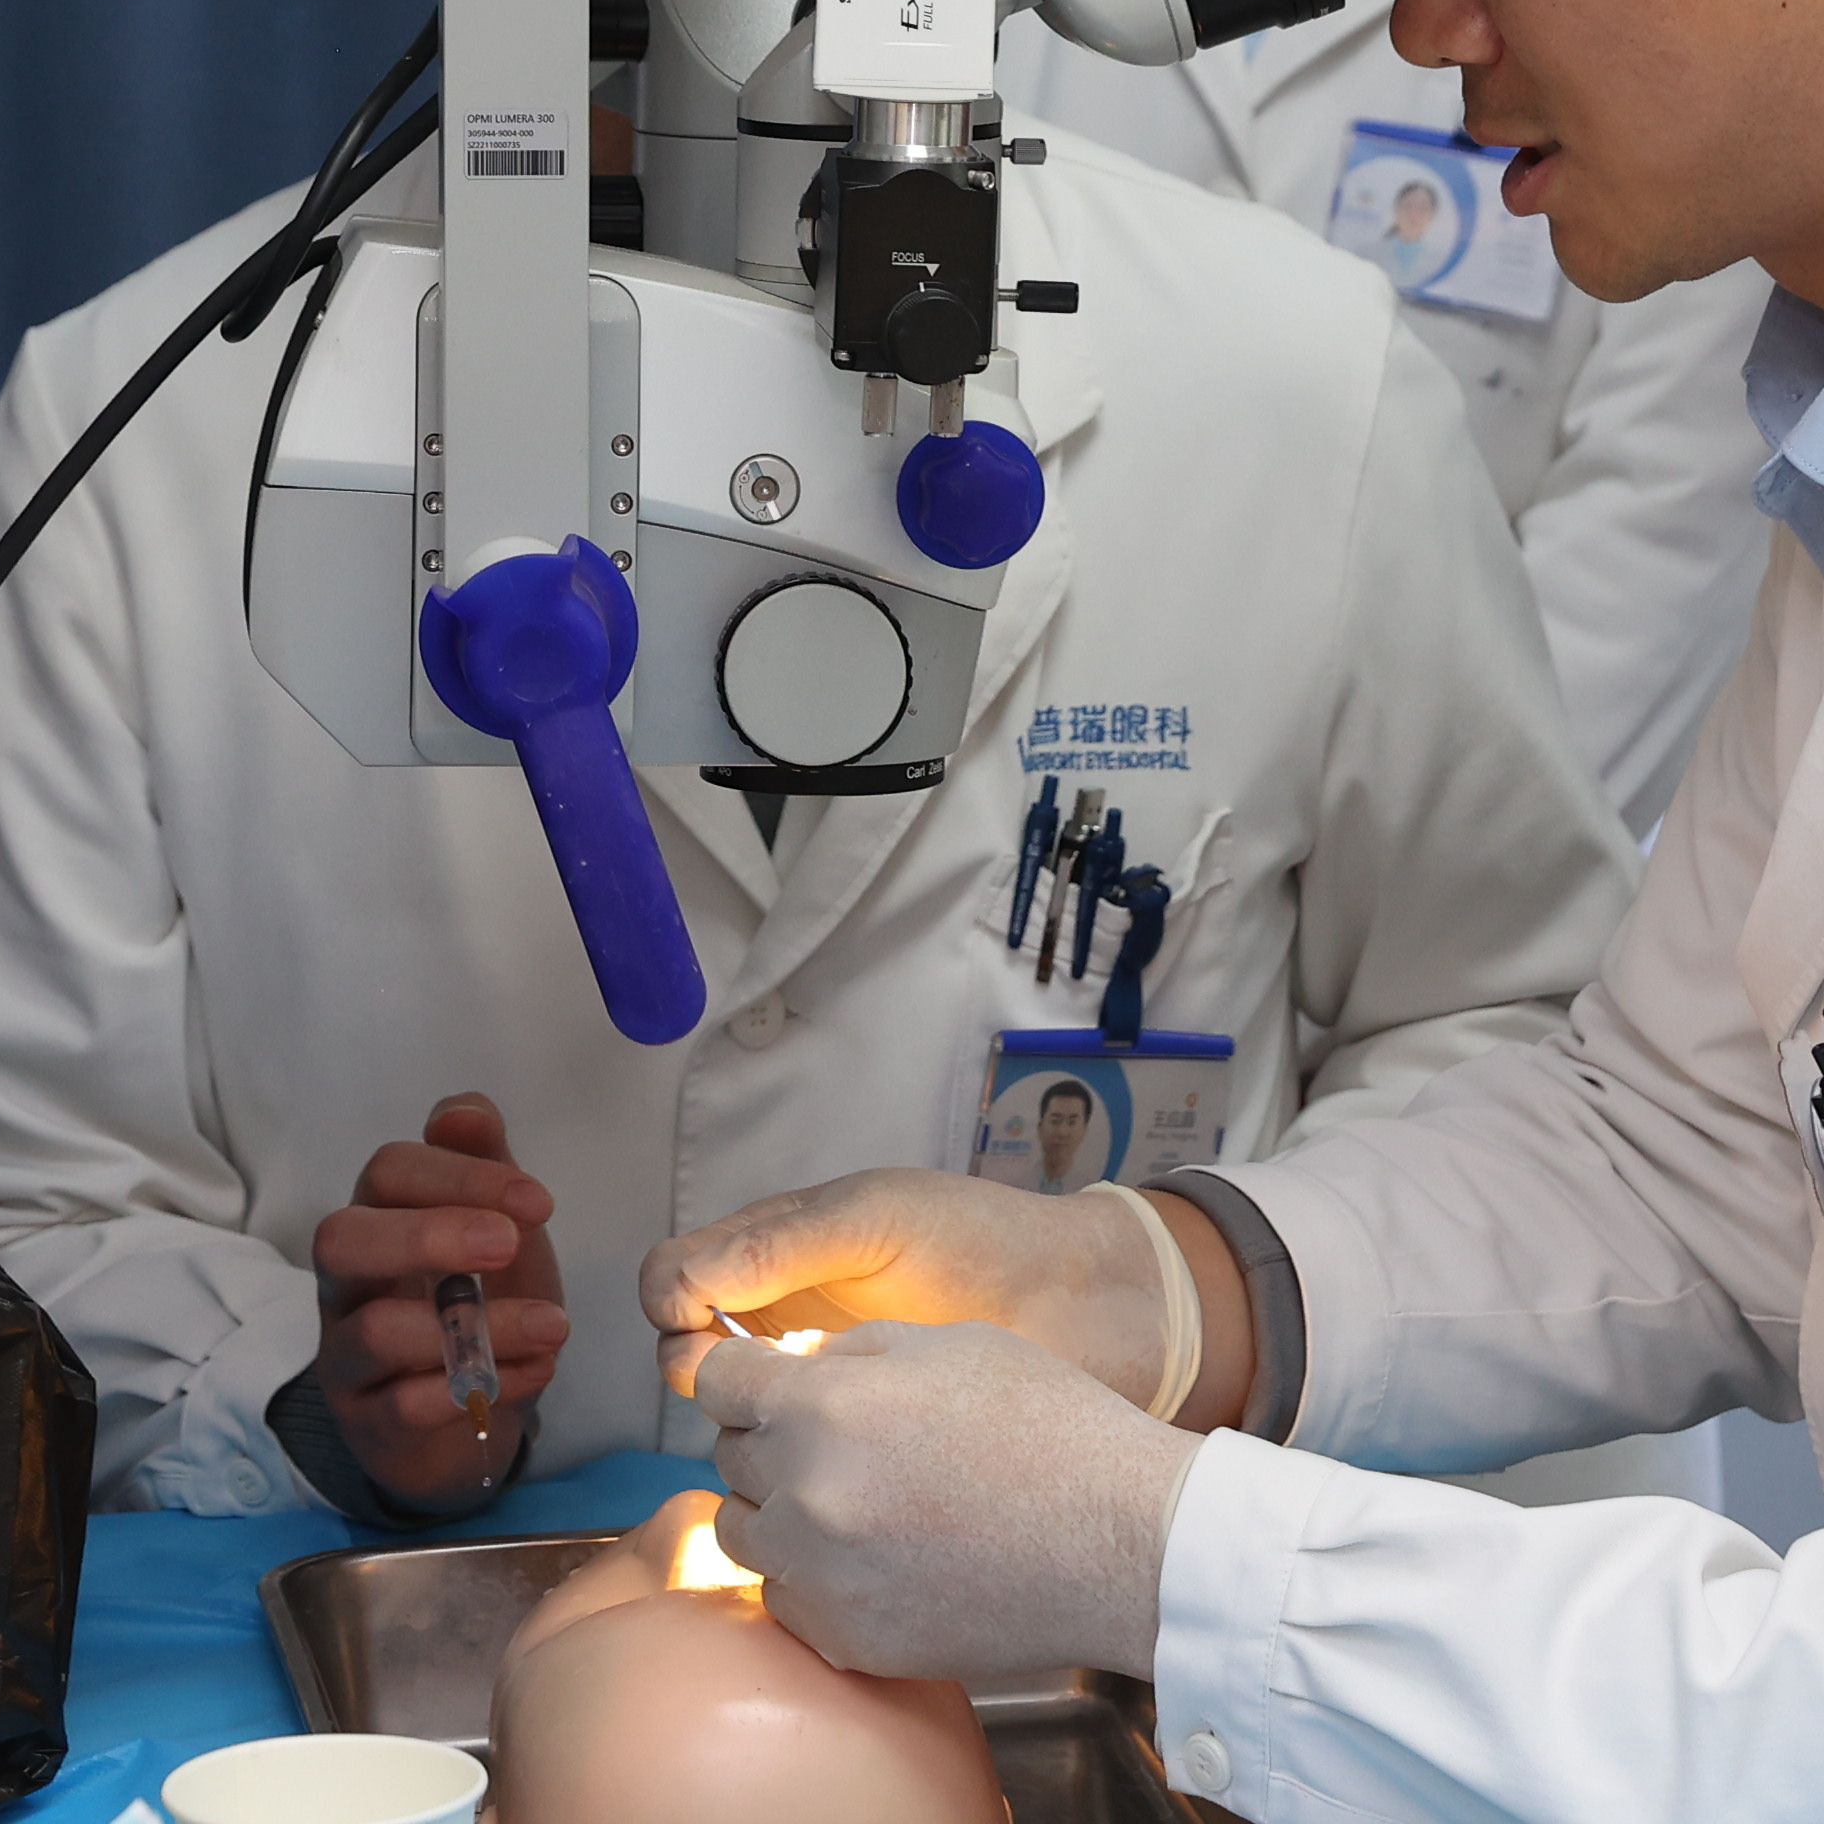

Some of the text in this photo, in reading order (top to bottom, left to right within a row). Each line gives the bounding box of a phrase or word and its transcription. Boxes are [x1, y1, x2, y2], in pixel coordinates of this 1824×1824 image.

[923, 2, 934, 31] FULL
[467, 114, 555, 124] OPMI LUMERA 300
[891, 252, 925, 263] FOCUS
[1028, 704, 1192, 749] 普瑞眼科
[907, 765, 926, 779] Carl
